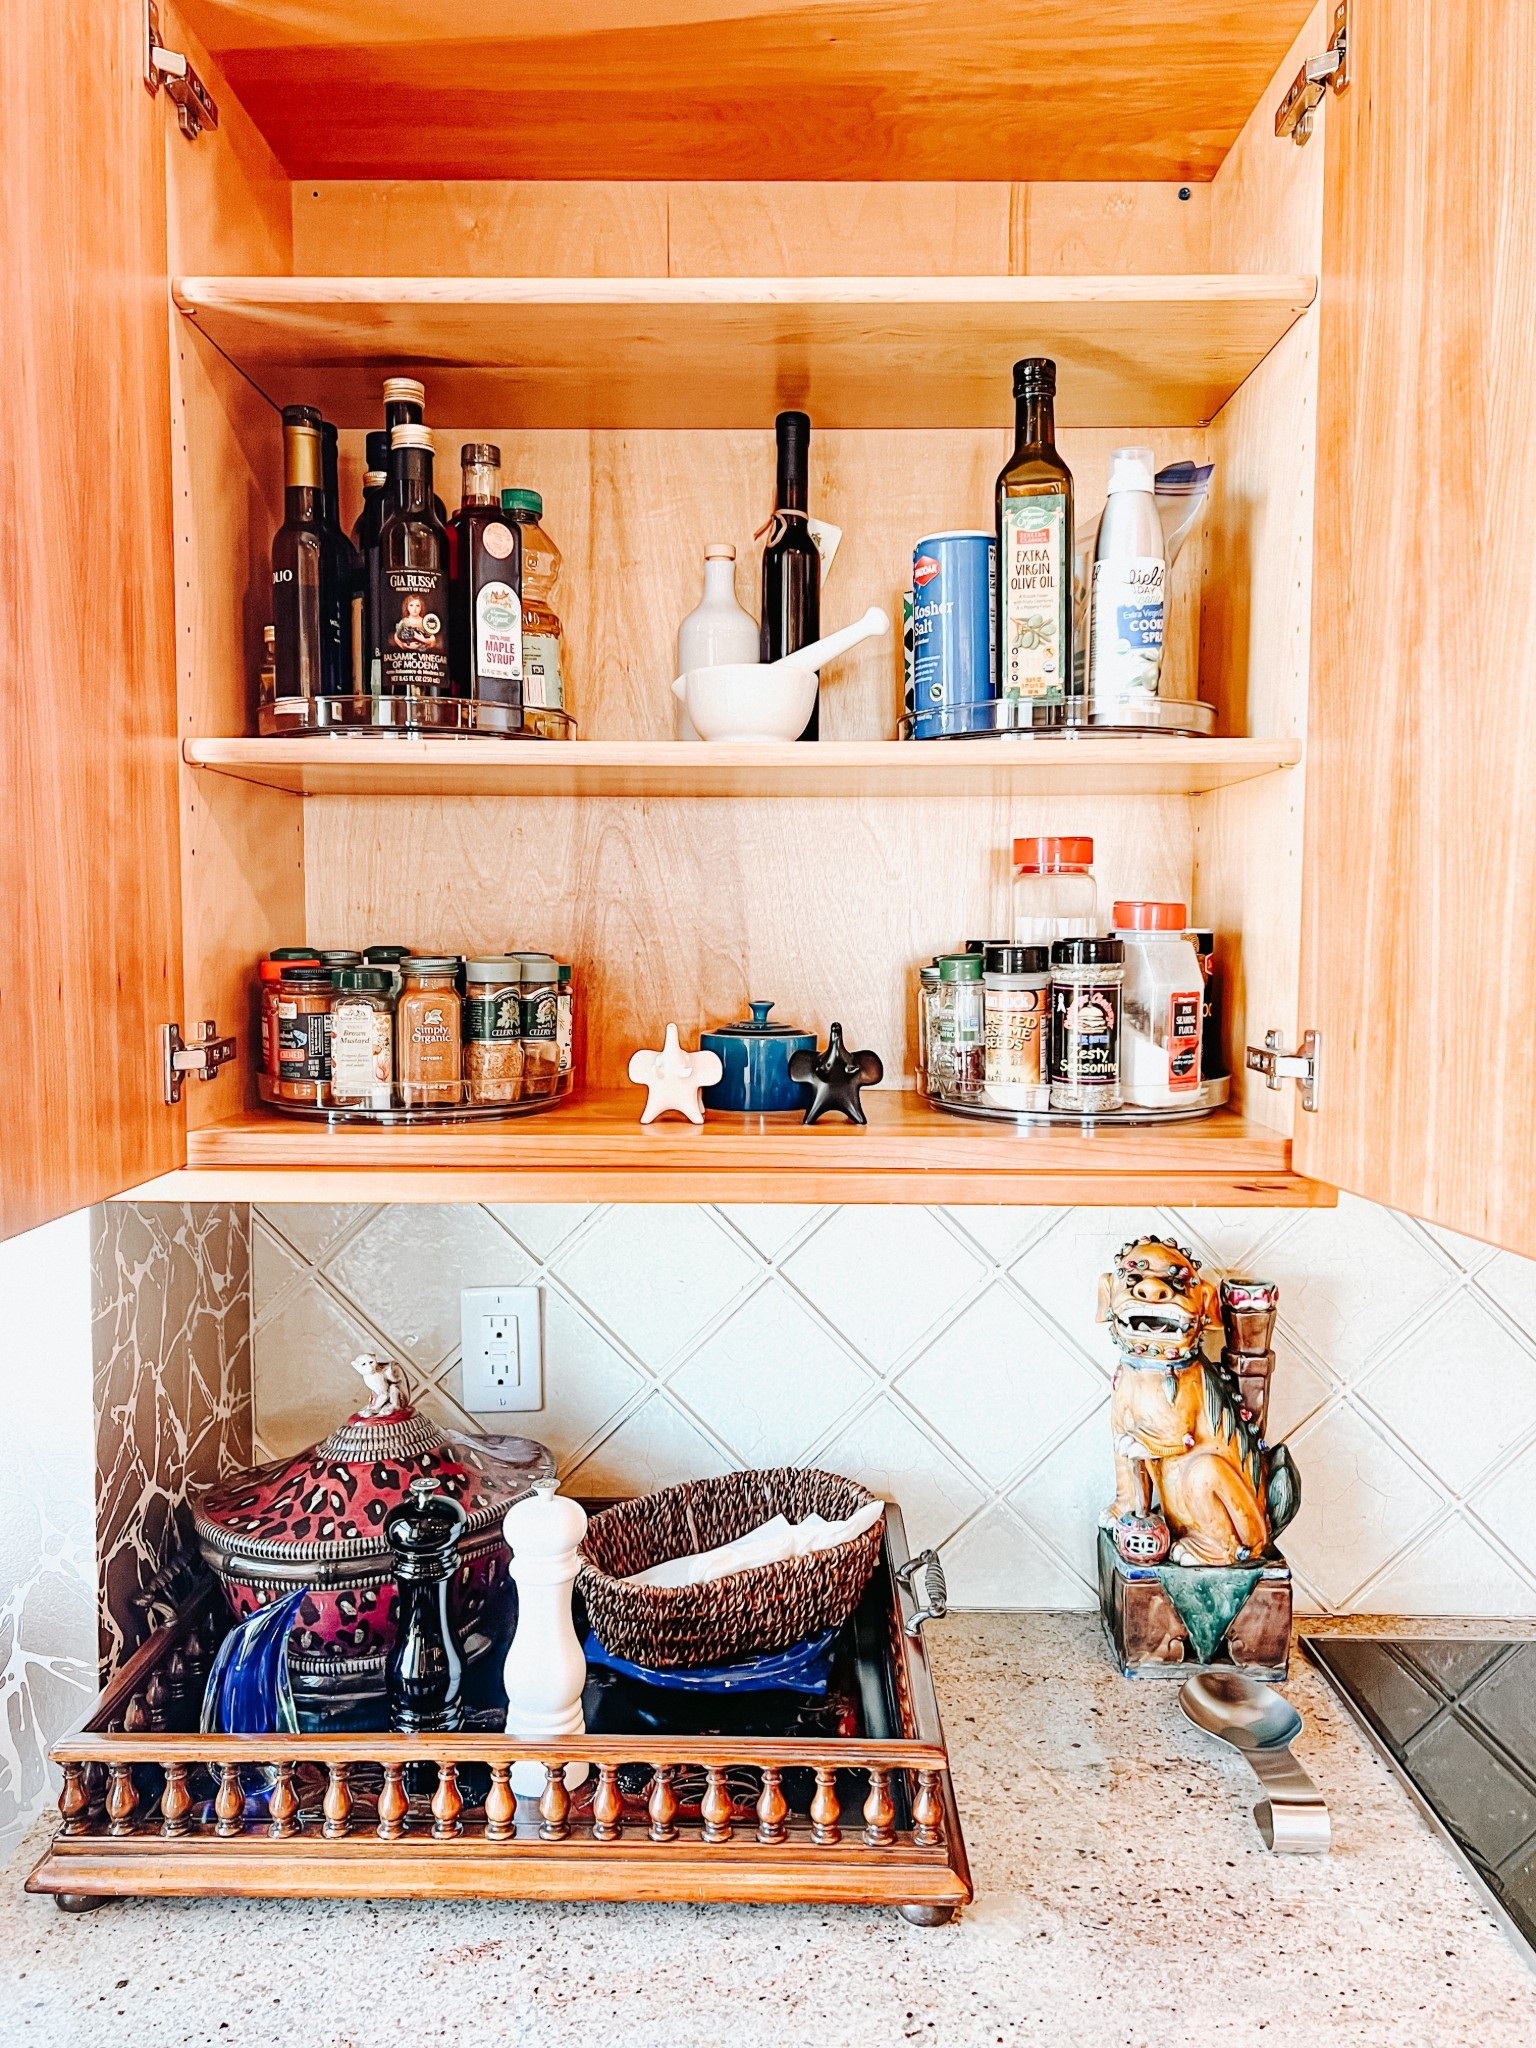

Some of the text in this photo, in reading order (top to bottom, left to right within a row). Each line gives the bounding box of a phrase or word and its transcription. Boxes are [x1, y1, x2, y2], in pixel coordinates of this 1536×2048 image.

[1016, 549, 1050, 563] EXTRA
[1015, 562, 1050, 576] VIRGIN
[390, 575, 406, 588] GIA
[1010, 575, 1055, 590] OLIVE OIL
[914, 618, 934, 637] Salt
[485, 640, 516, 655] MAPLE
[384, 652, 448, 665] BALSAMIC VINEGAR
[486, 652, 515, 665] SYRUP
[392, 660, 439, 671] OF MODENA
[343, 1029, 366, 1037] Brown
[414, 1025, 449, 1036] Simply
[492, 1029, 513, 1037] CELERY
[529, 1028, 551, 1036] CELERY
[985, 1024, 1033, 1040] ESAME
[1060, 1059, 1118, 1076] Seasoning
